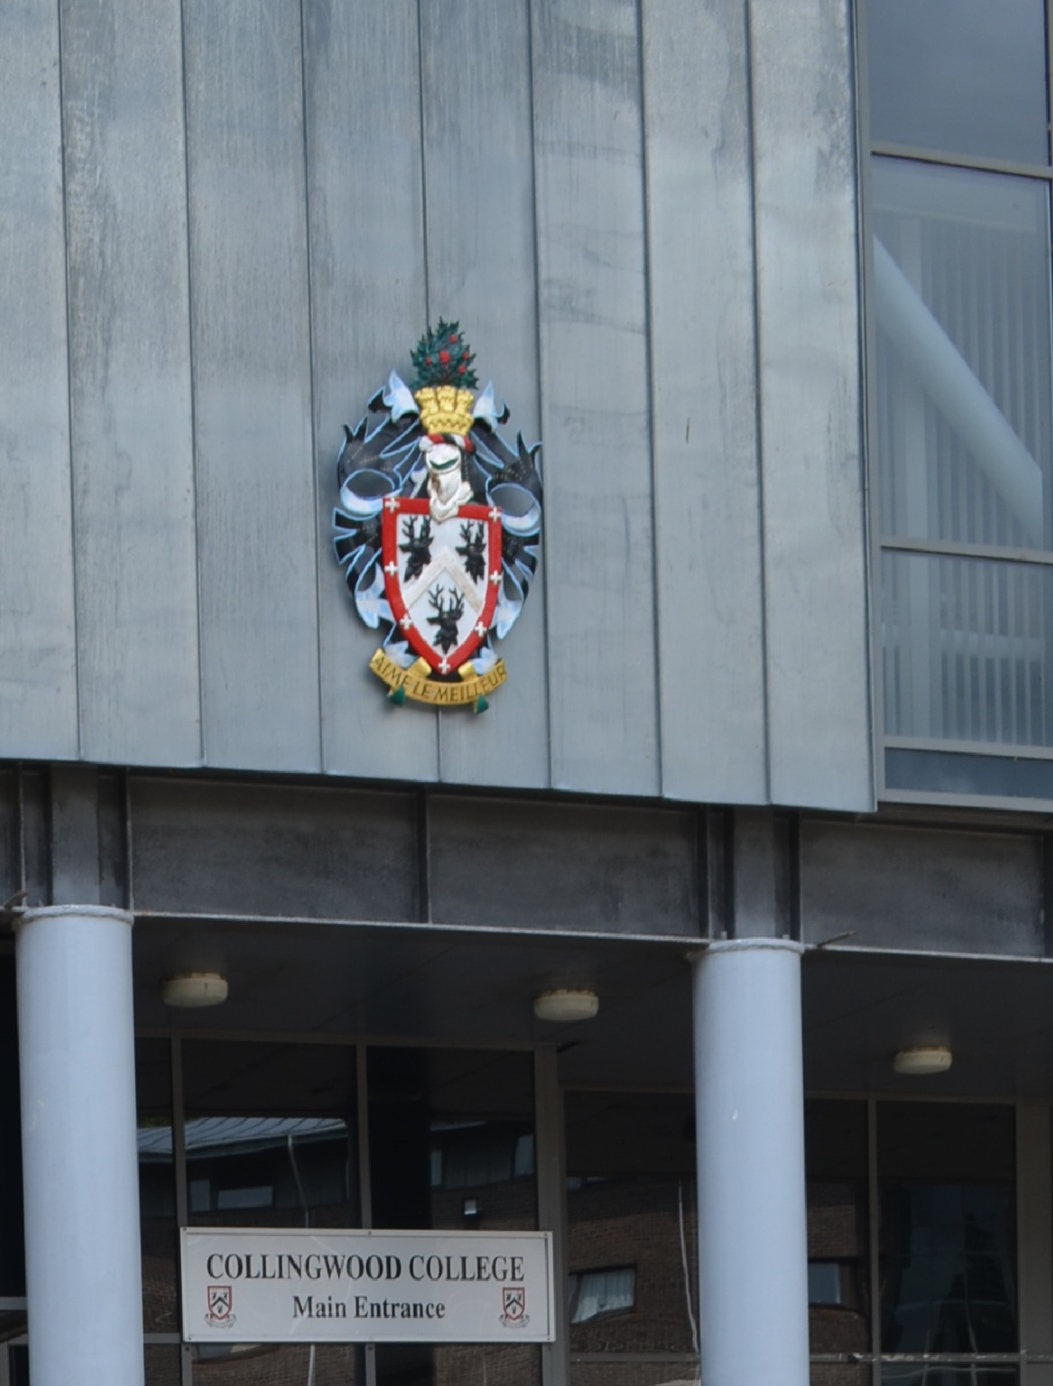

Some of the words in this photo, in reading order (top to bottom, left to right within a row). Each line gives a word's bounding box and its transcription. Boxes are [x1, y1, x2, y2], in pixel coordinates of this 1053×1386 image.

[412, 682, 432, 698] LE
[436, 665, 507, 702] MEILLEUR
[206, 1253, 402, 1281] COLLINGWOOD
[409, 1255, 525, 1282] COLLEGE
[292, 1295, 347, 1320] Main
[353, 1296, 446, 1320] Entrance
